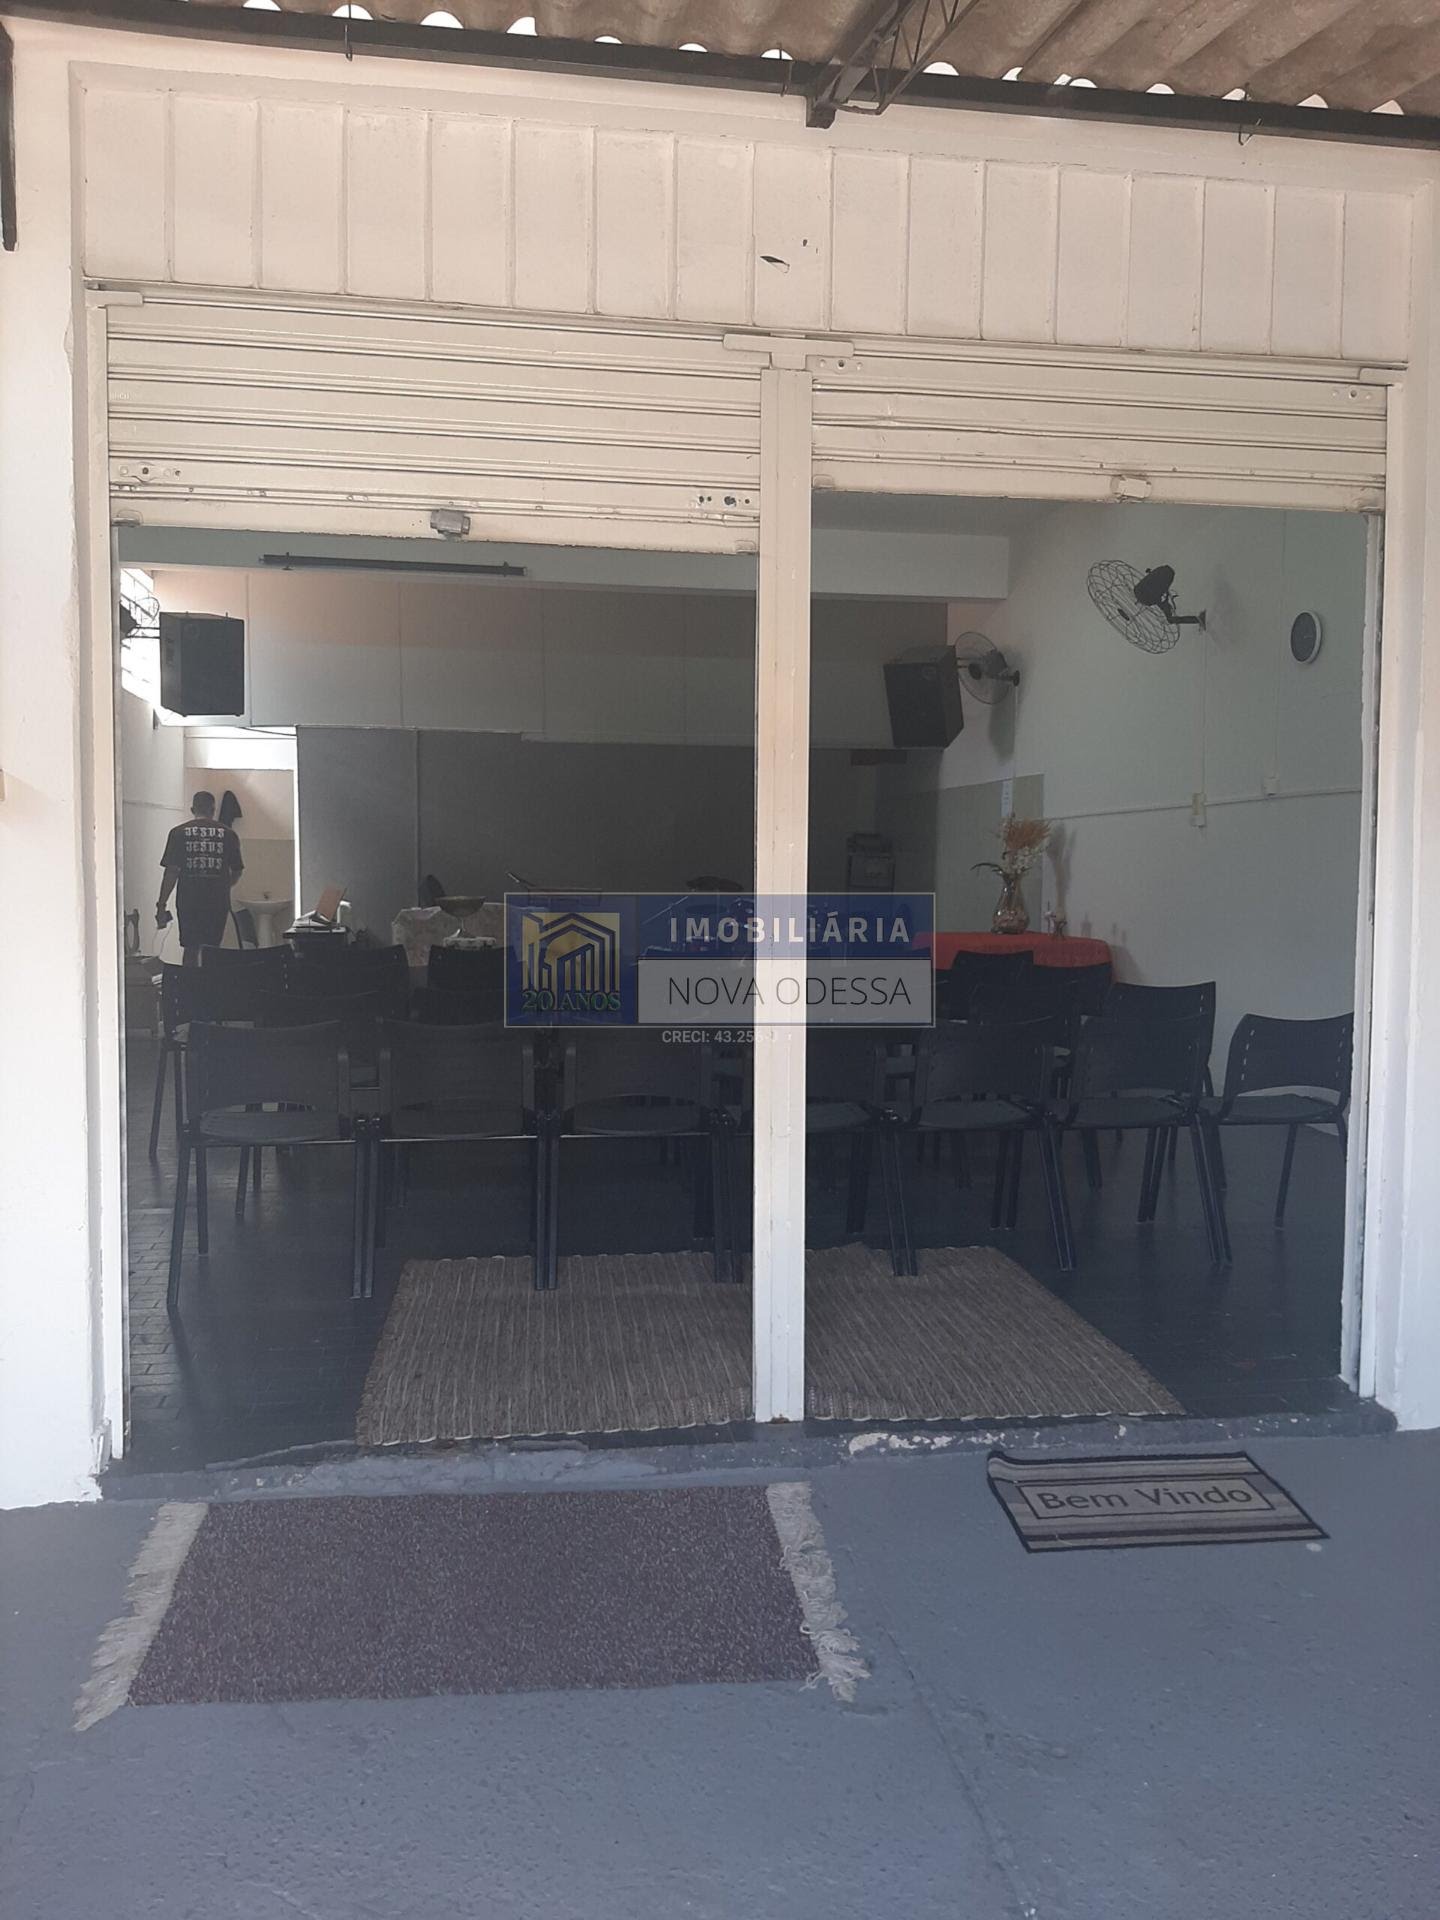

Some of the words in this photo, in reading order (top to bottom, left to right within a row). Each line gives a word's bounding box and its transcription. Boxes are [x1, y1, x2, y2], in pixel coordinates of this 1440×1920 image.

[184, 826, 225, 838] JESUS
[185, 841, 224, 854] JESUS
[186, 856, 223, 869] JESUS
[1036, 1490, 1129, 1510] Bem
[1134, 1485, 1252, 1507] Vindo
